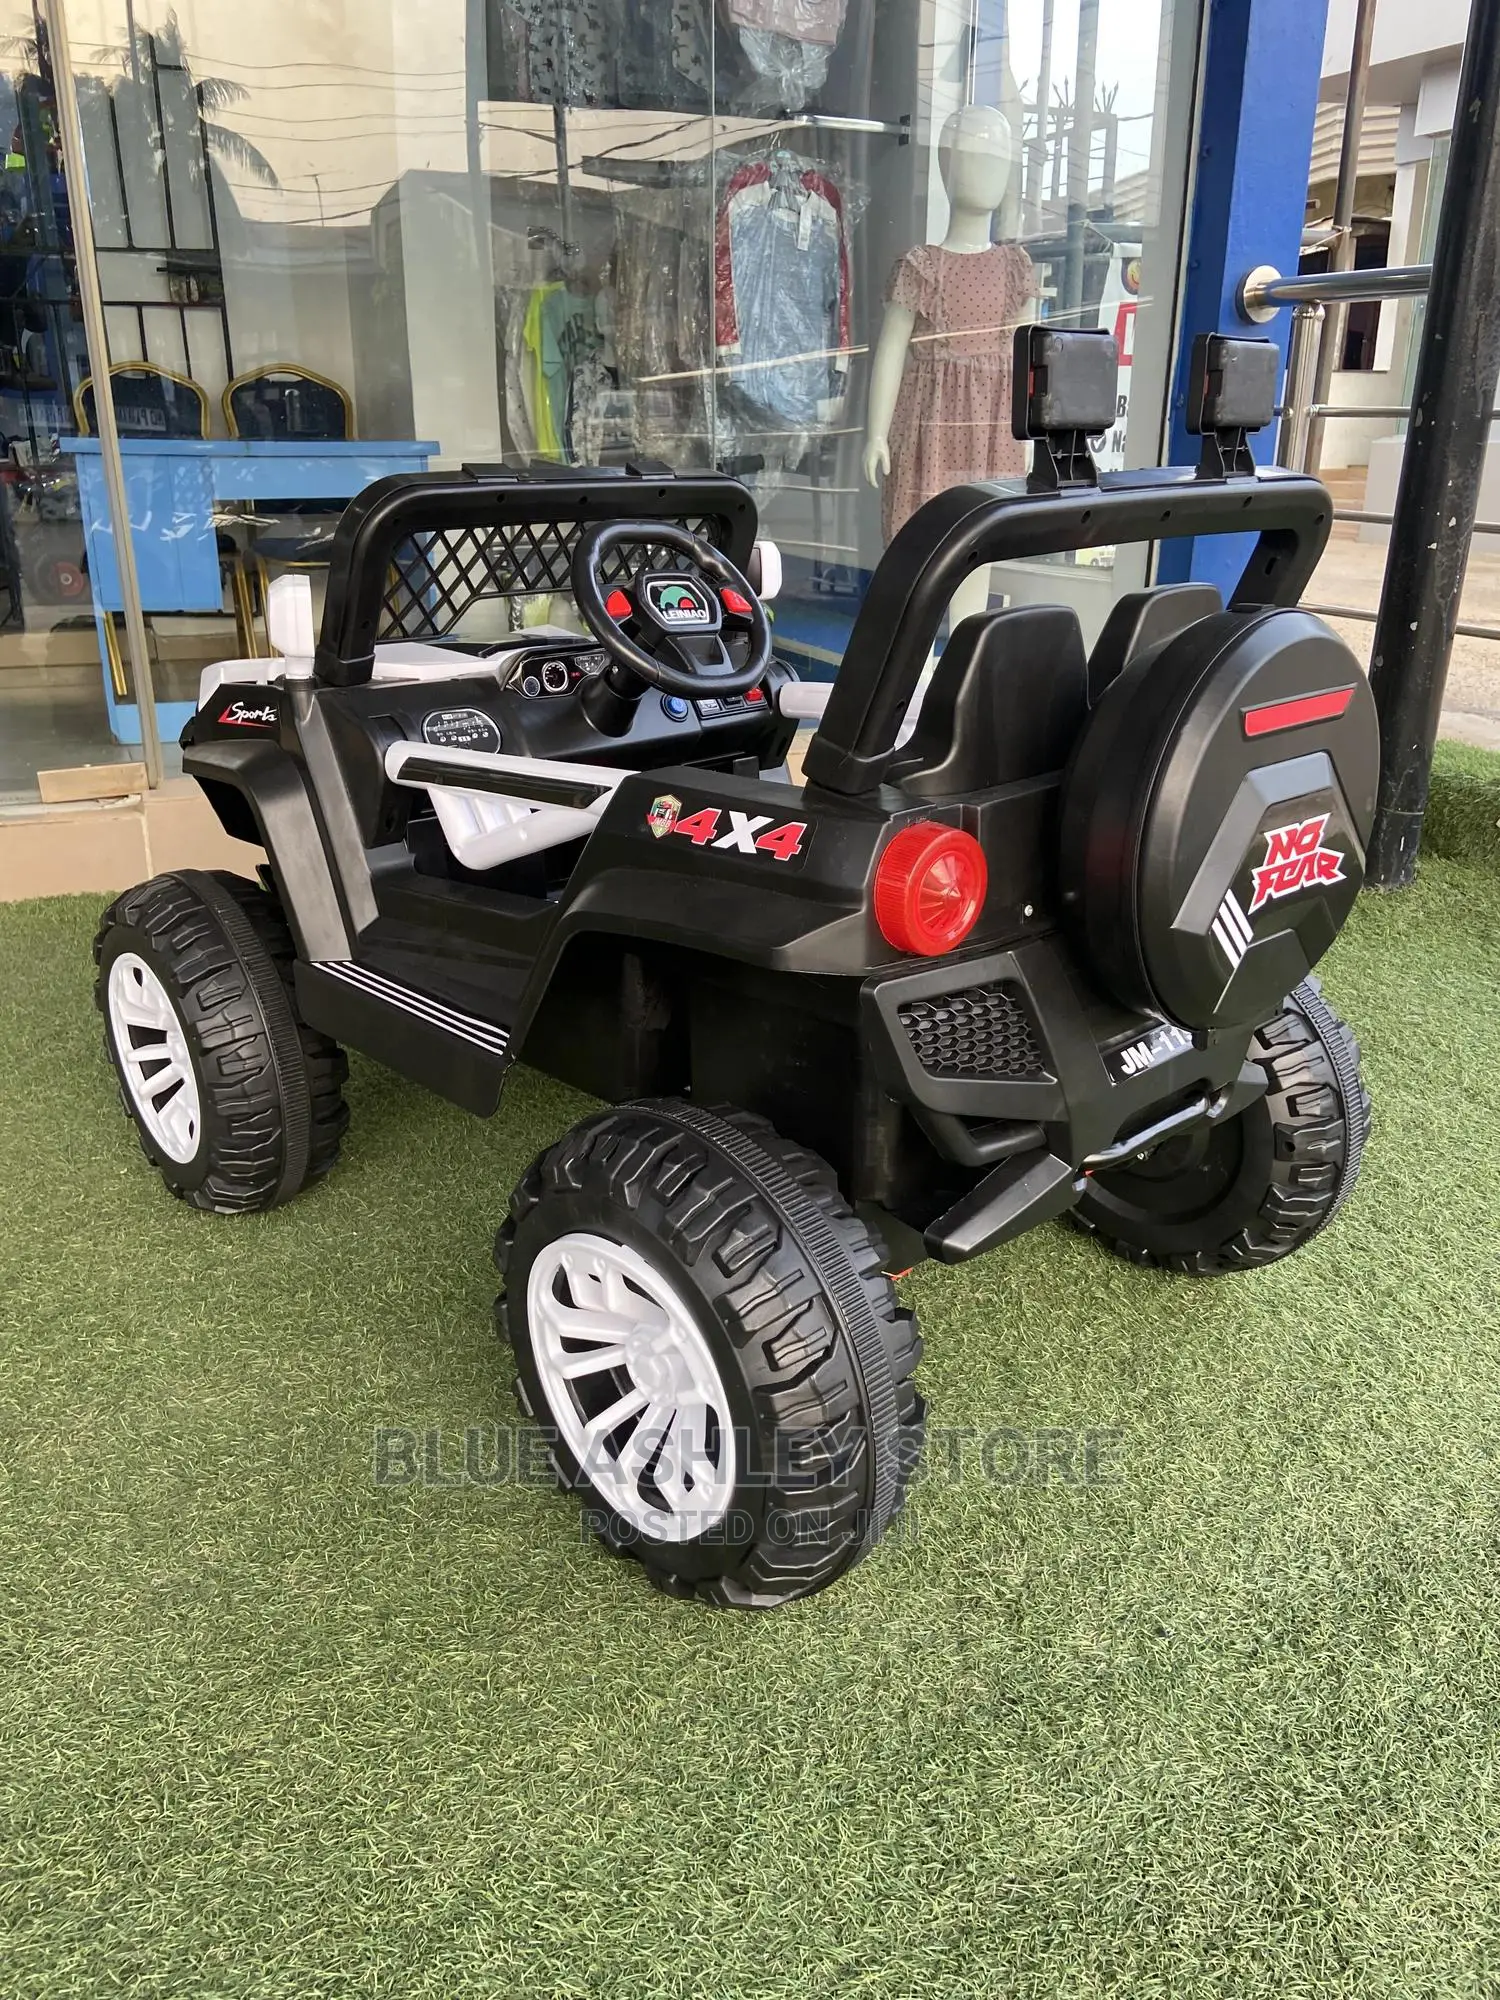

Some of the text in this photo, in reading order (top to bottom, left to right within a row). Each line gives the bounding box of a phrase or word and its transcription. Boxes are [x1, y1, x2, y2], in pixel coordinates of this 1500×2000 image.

[663, 608, 707, 620] LEINIAO
[226, 701, 277, 724] Sports
[674, 807, 808, 862] 4X4
[1264, 815, 1329, 866] NO
[1249, 848, 1345, 912] FEAR
